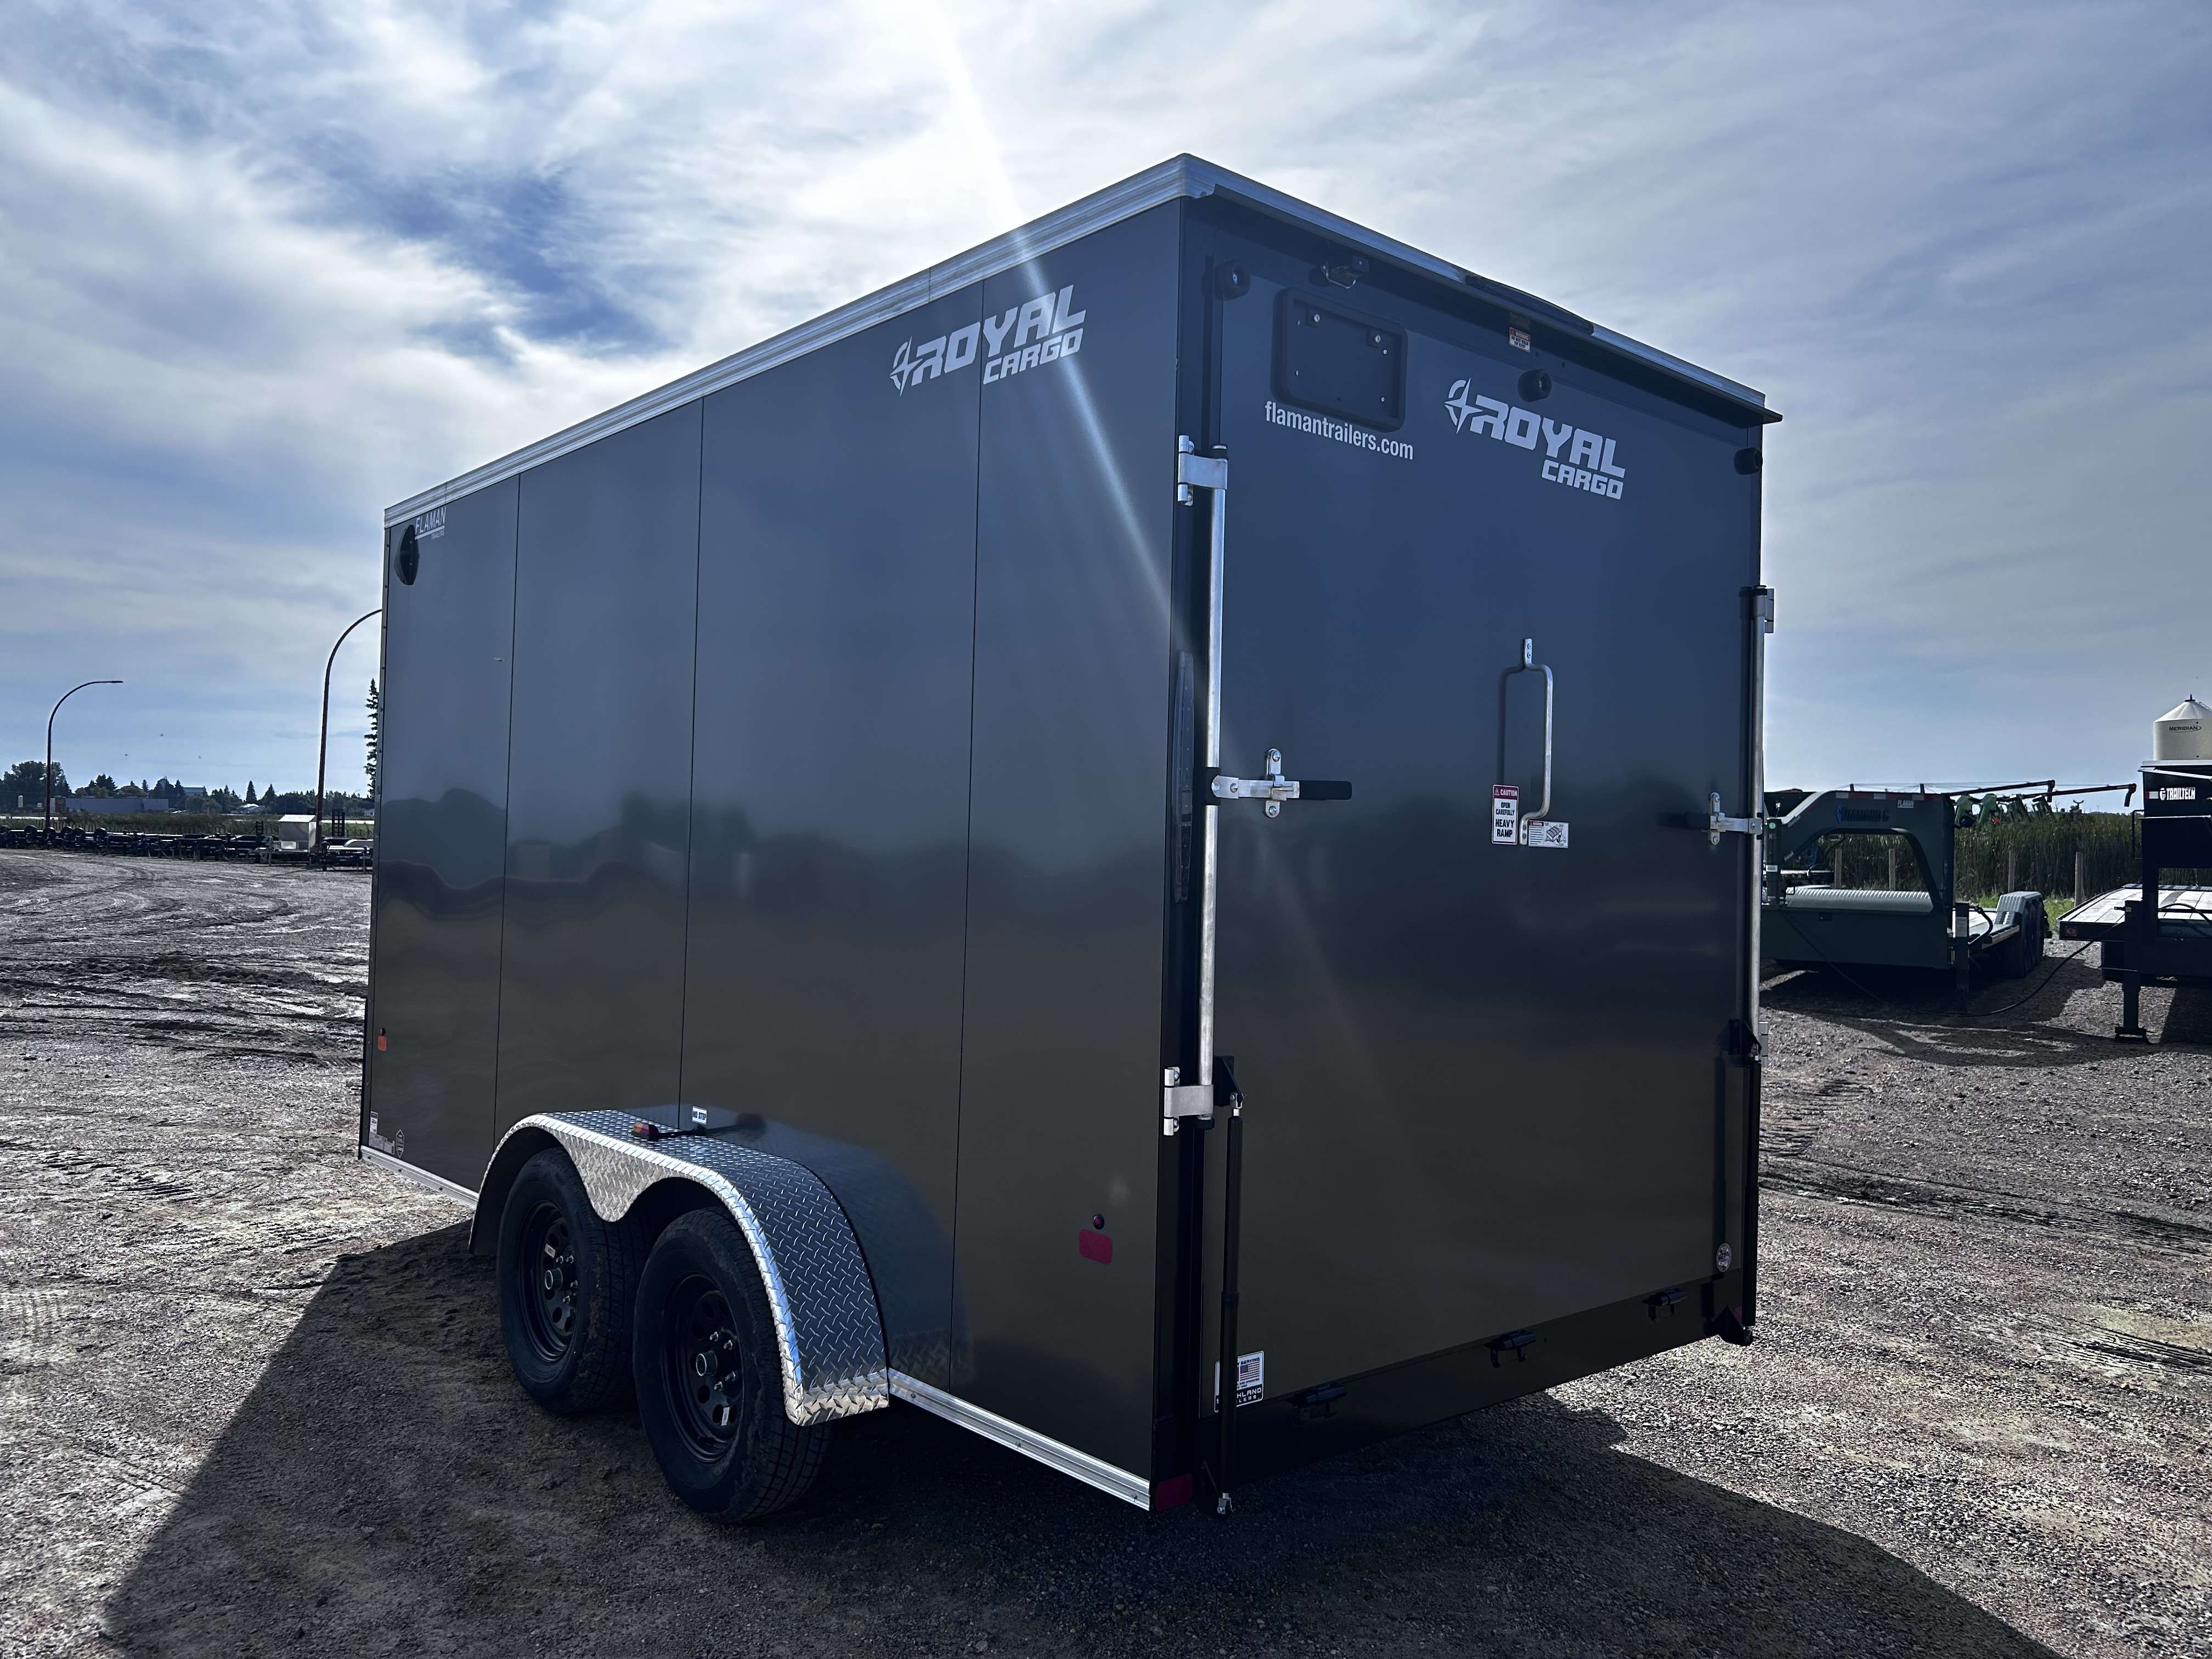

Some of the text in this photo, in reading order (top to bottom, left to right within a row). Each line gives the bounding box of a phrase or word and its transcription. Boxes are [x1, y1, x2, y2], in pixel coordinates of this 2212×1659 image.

[911, 285, 1086, 386] ROYAL
[983, 328, 1084, 385] CARGO
[1265, 401, 1414, 460] flamantrailers.com
[1470, 394, 1626, 478] ROYAL
[1542, 459, 1623, 500] CARGO
[415, 505, 447, 535] FLAMAN
[2166, 787, 2196, 800] TRAILTECH
[1495, 819, 1515, 828] HEAVY
[1497, 829, 1513, 838] RAMP
[698, 1111, 707, 1120] STEP
